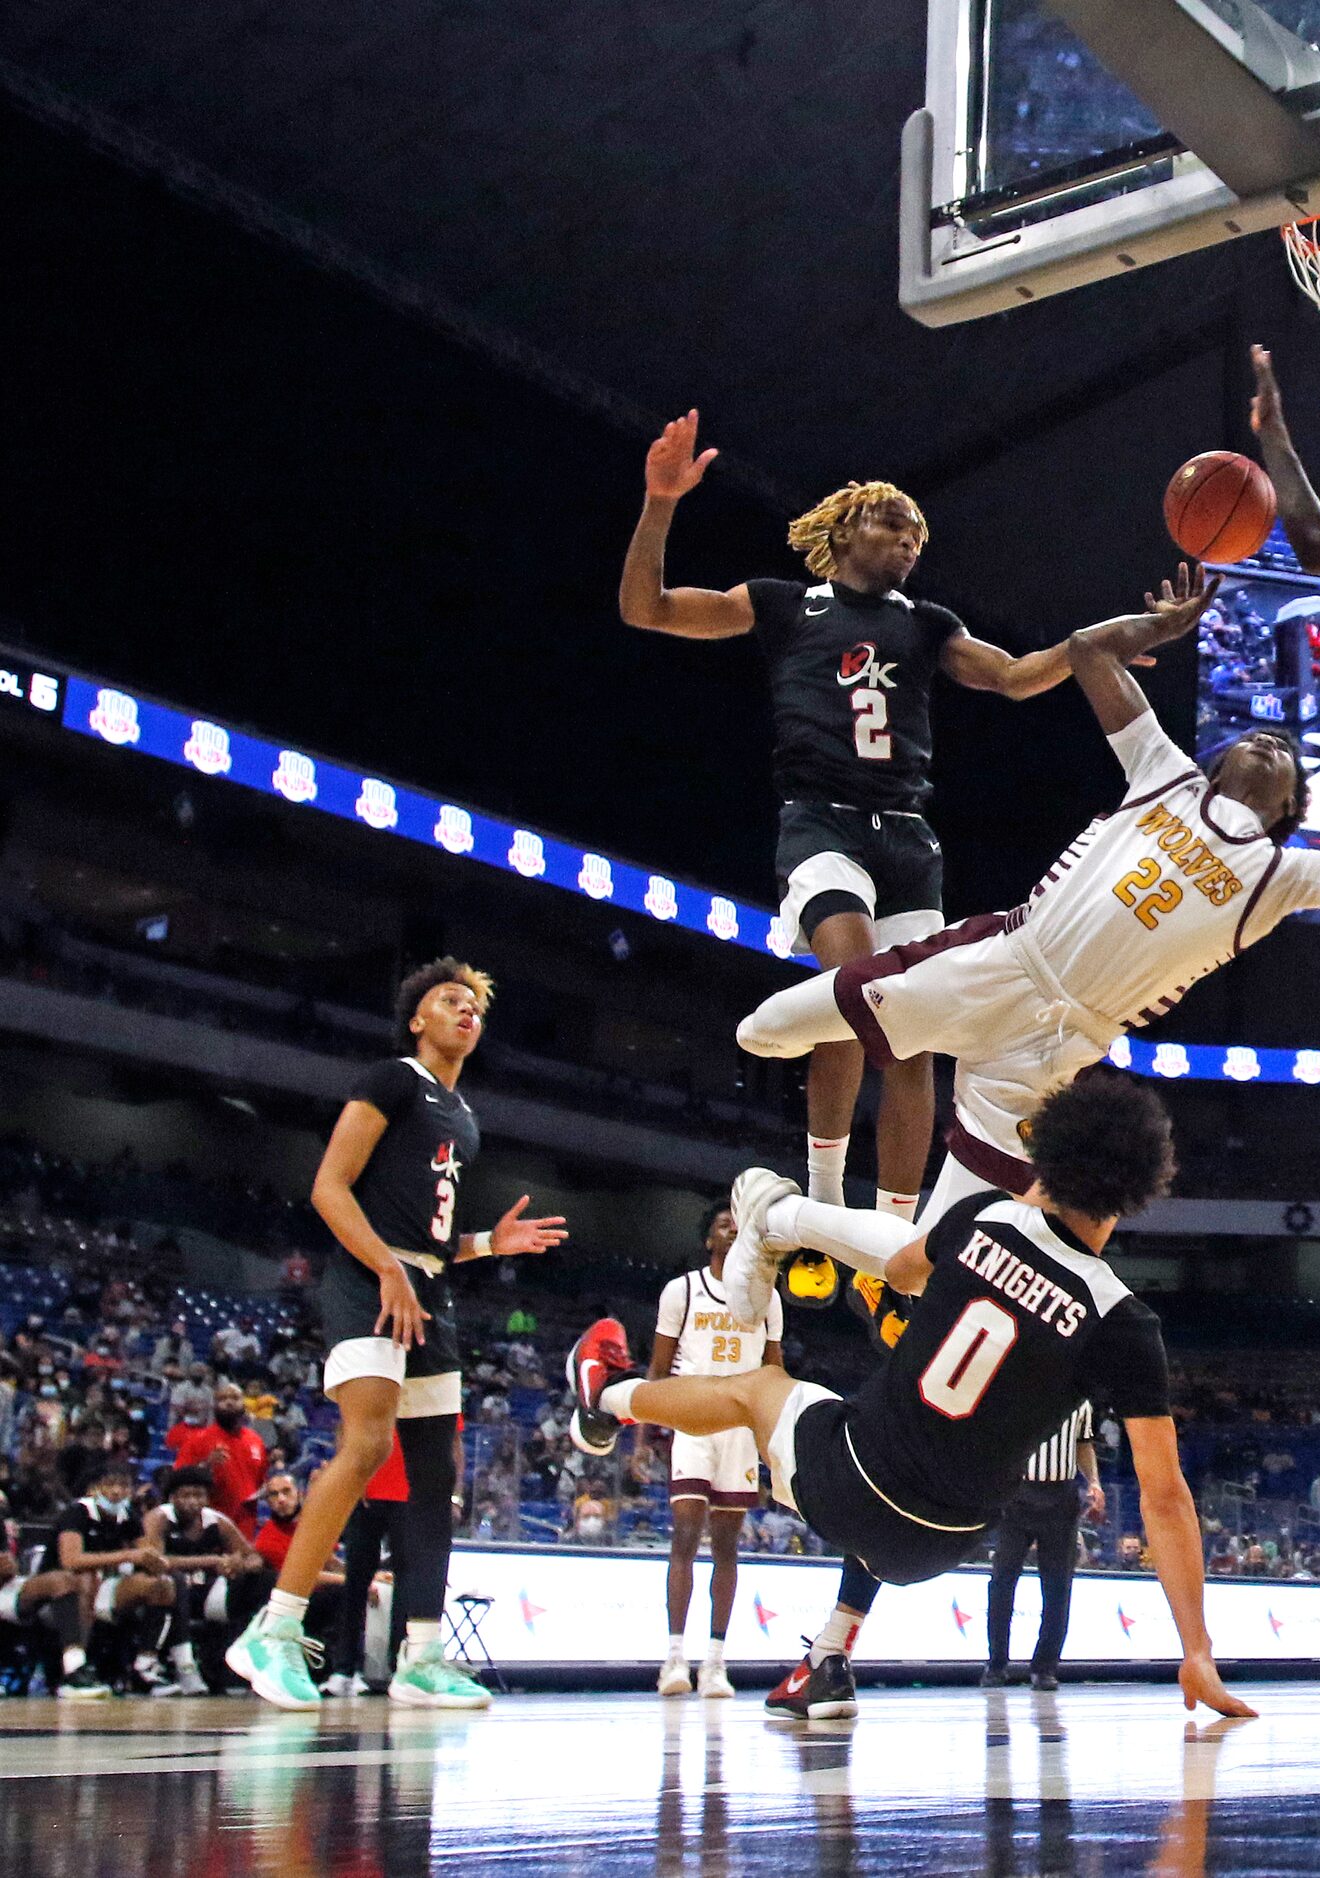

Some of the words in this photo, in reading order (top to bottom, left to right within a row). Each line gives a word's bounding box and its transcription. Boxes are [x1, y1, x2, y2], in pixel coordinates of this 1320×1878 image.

[850, 687, 892, 760] 2
[1136, 803, 1243, 906] WOLVES
[1112, 857, 1183, 930] 22
[429, 1178, 456, 1243] 3
[957, 1228, 1088, 1338] KNIGHTS
[712, 1336, 742, 1363] 23
[917, 1295, 1020, 1421] 0
